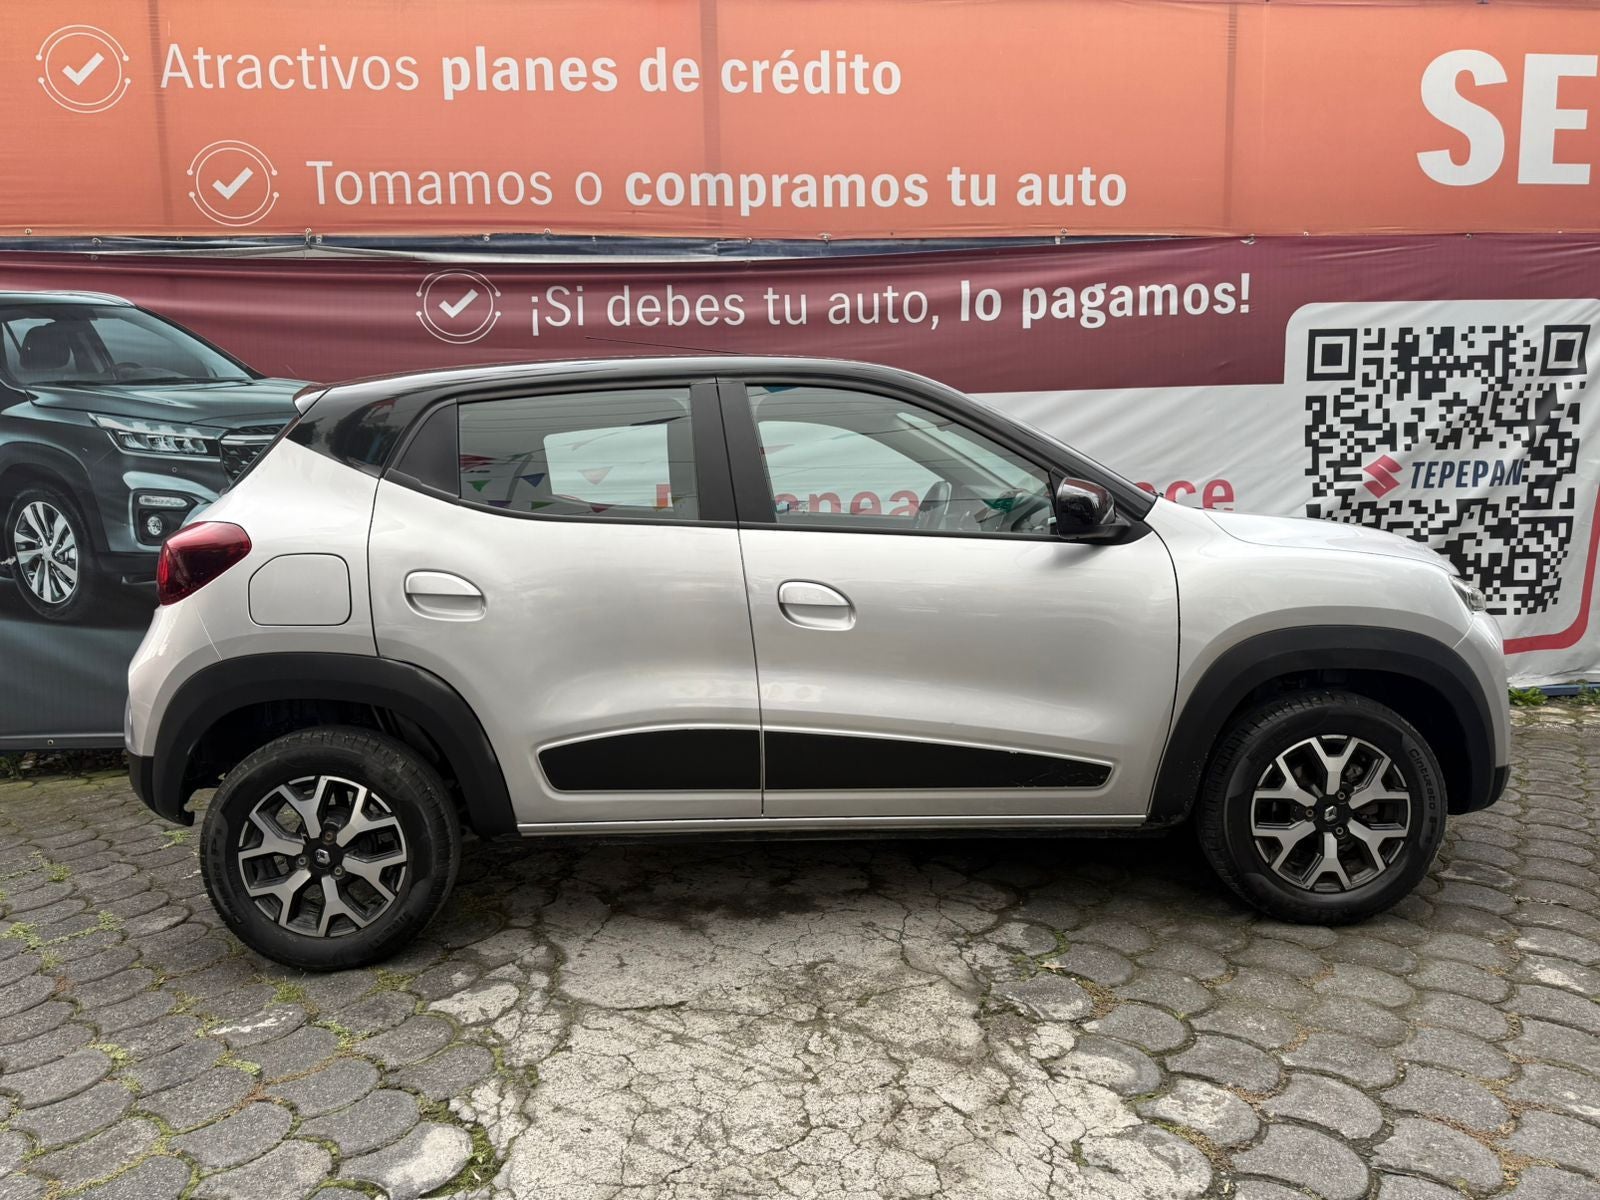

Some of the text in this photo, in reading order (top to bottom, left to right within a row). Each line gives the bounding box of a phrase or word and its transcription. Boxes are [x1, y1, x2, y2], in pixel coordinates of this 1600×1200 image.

[160, 43, 902, 102] Atractivos planes de crédito
[1417, 49, 1600, 187] SE
[305, 160, 1128, 218] Tomamos o compramos tu auto
[530, 272, 1251, 336] ¡Si debes tu auto, lo pagamos!
[1410, 459, 1525, 490] TEPEPAN
